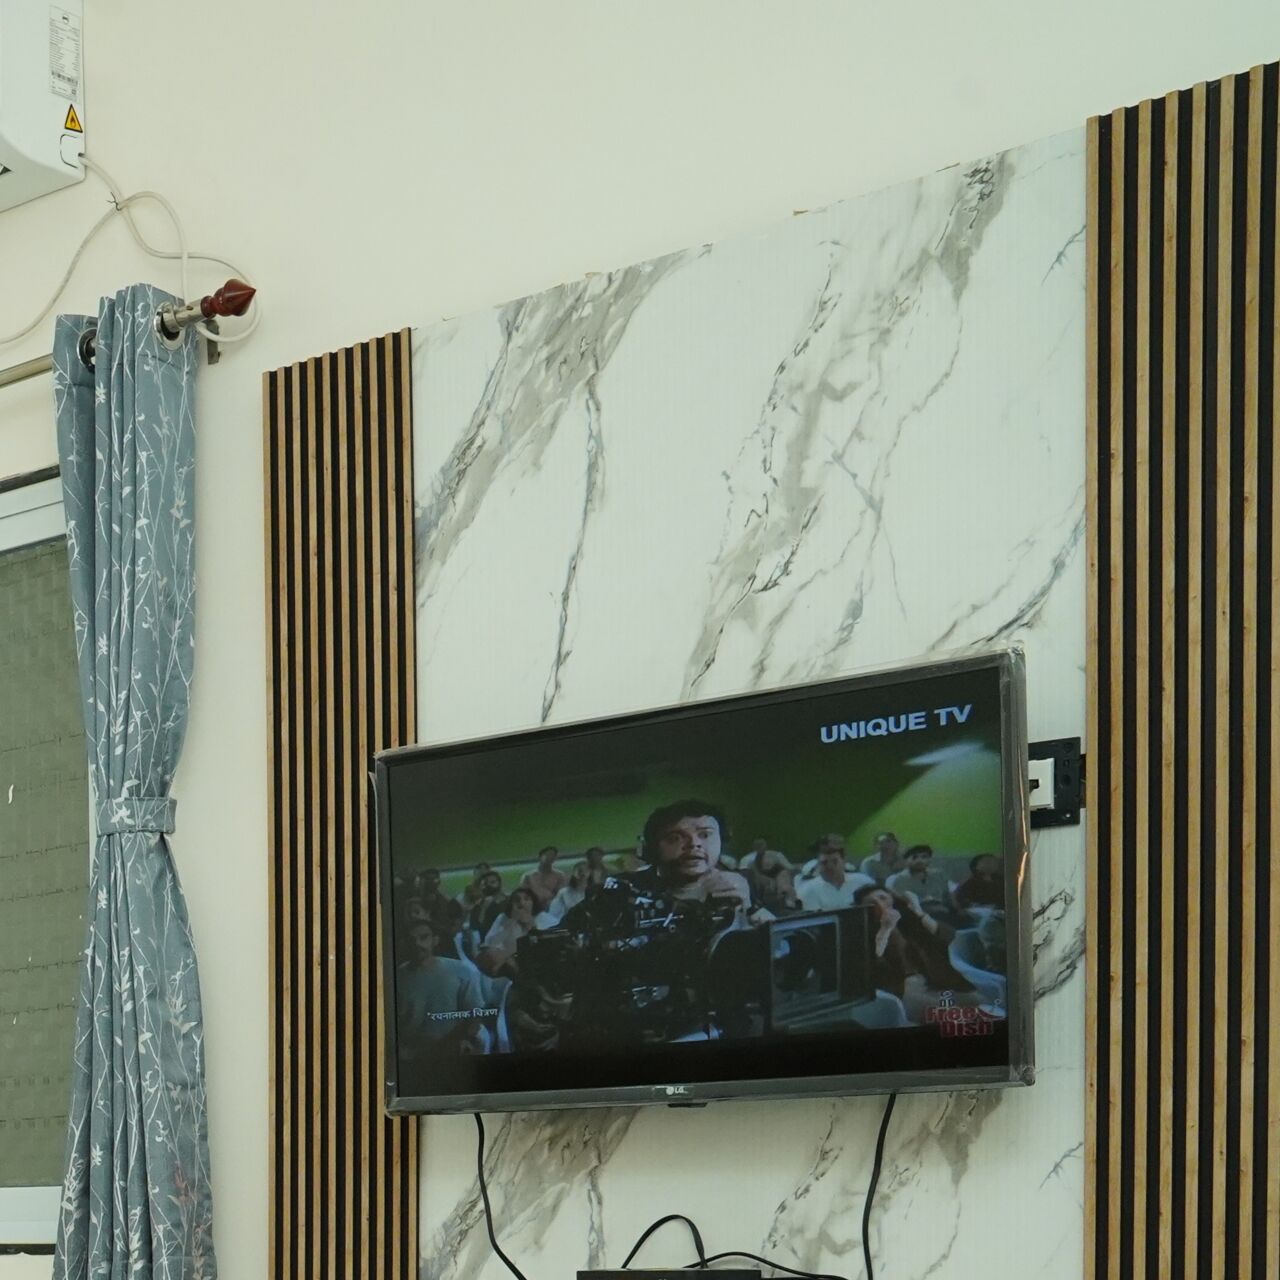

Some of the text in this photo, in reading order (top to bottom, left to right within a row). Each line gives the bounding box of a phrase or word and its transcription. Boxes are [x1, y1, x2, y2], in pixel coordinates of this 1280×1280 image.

[820, 704, 973, 744] UNIQUE TV
[925, 1005, 979, 1023] Free
[939, 1017, 995, 1038] Dish
